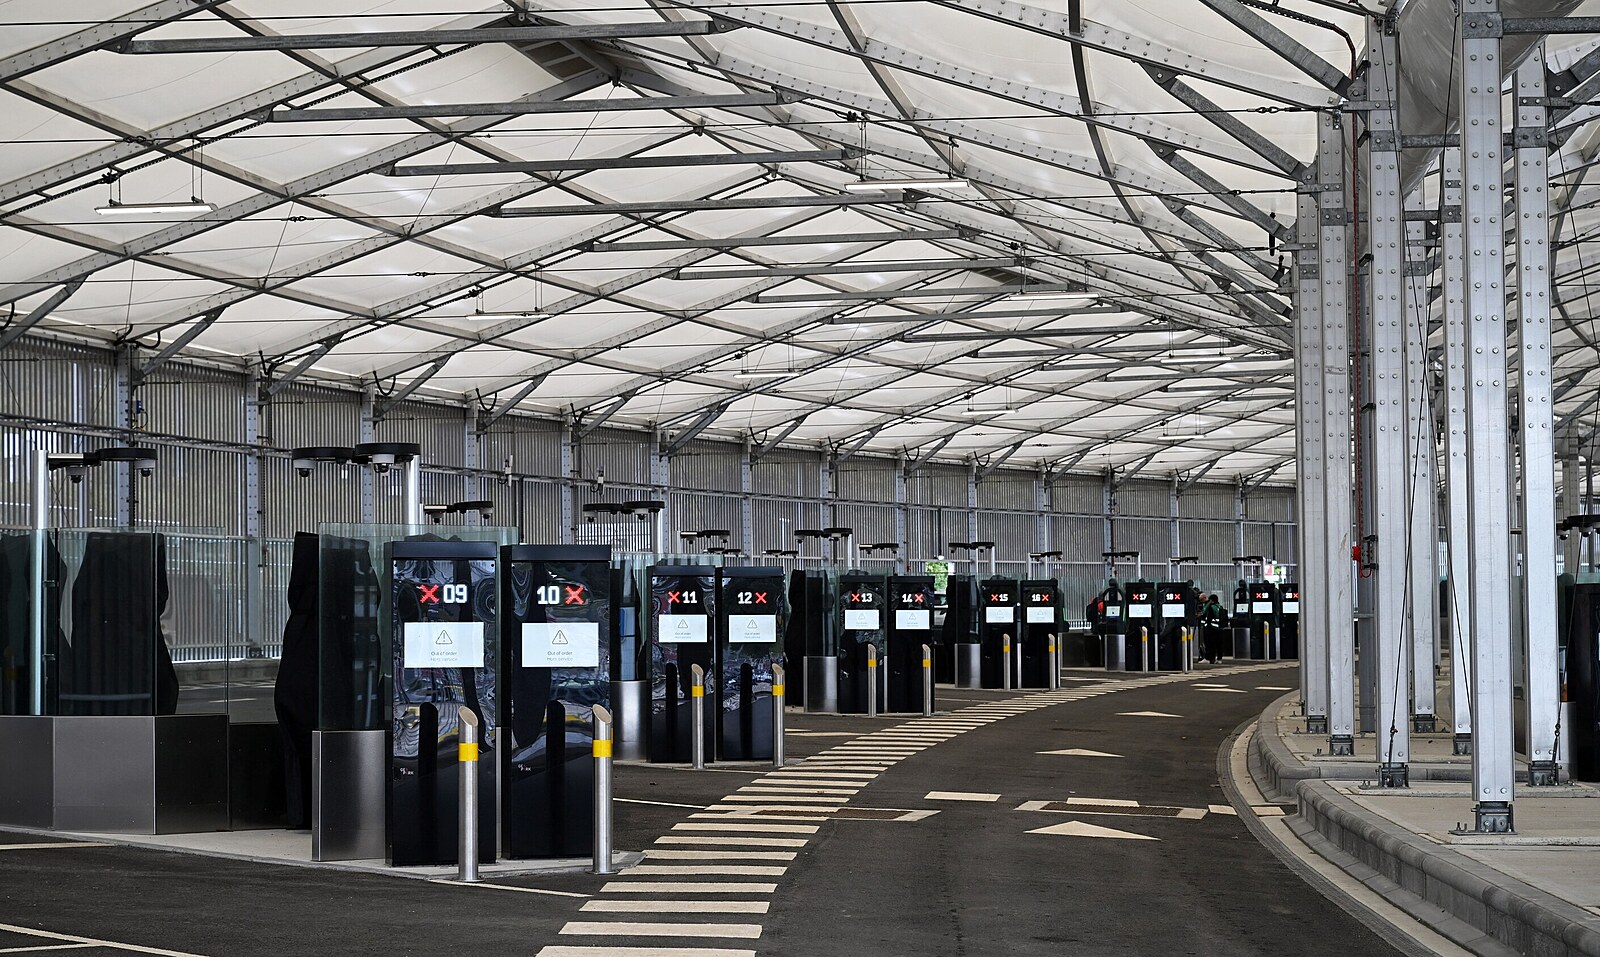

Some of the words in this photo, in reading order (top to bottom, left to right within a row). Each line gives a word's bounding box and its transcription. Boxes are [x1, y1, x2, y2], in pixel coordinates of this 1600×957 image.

[443, 583, 468, 603] 09
[536, 585, 560, 605] 10
[682, 590, 698, 604] 11
[737, 591, 752, 604] 12
[861, 593, 872, 602] 13
[998, 593, 1009, 602] 15
